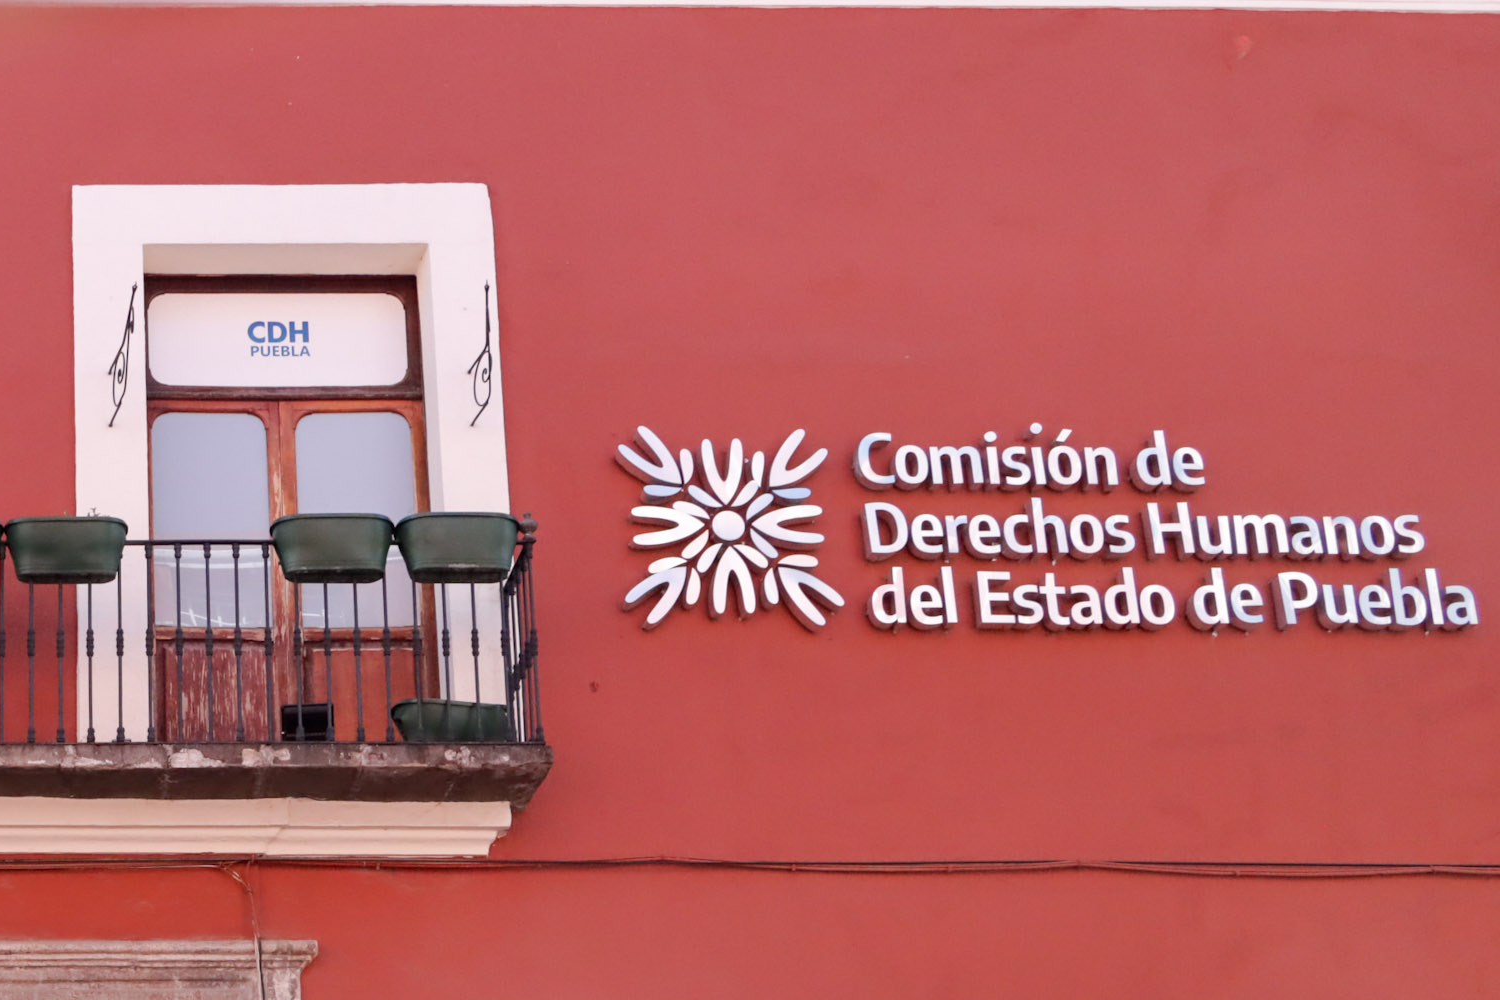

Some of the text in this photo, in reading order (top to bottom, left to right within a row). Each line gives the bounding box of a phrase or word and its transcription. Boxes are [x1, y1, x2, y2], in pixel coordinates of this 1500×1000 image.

[247, 320, 310, 343] CDH
[250, 345, 311, 357] PUEBLA
[855, 422, 1206, 488] Comisión de
[863, 497, 1427, 556] Derechos Humanos
[870, 566, 1480, 627] del Estado de Puebla
